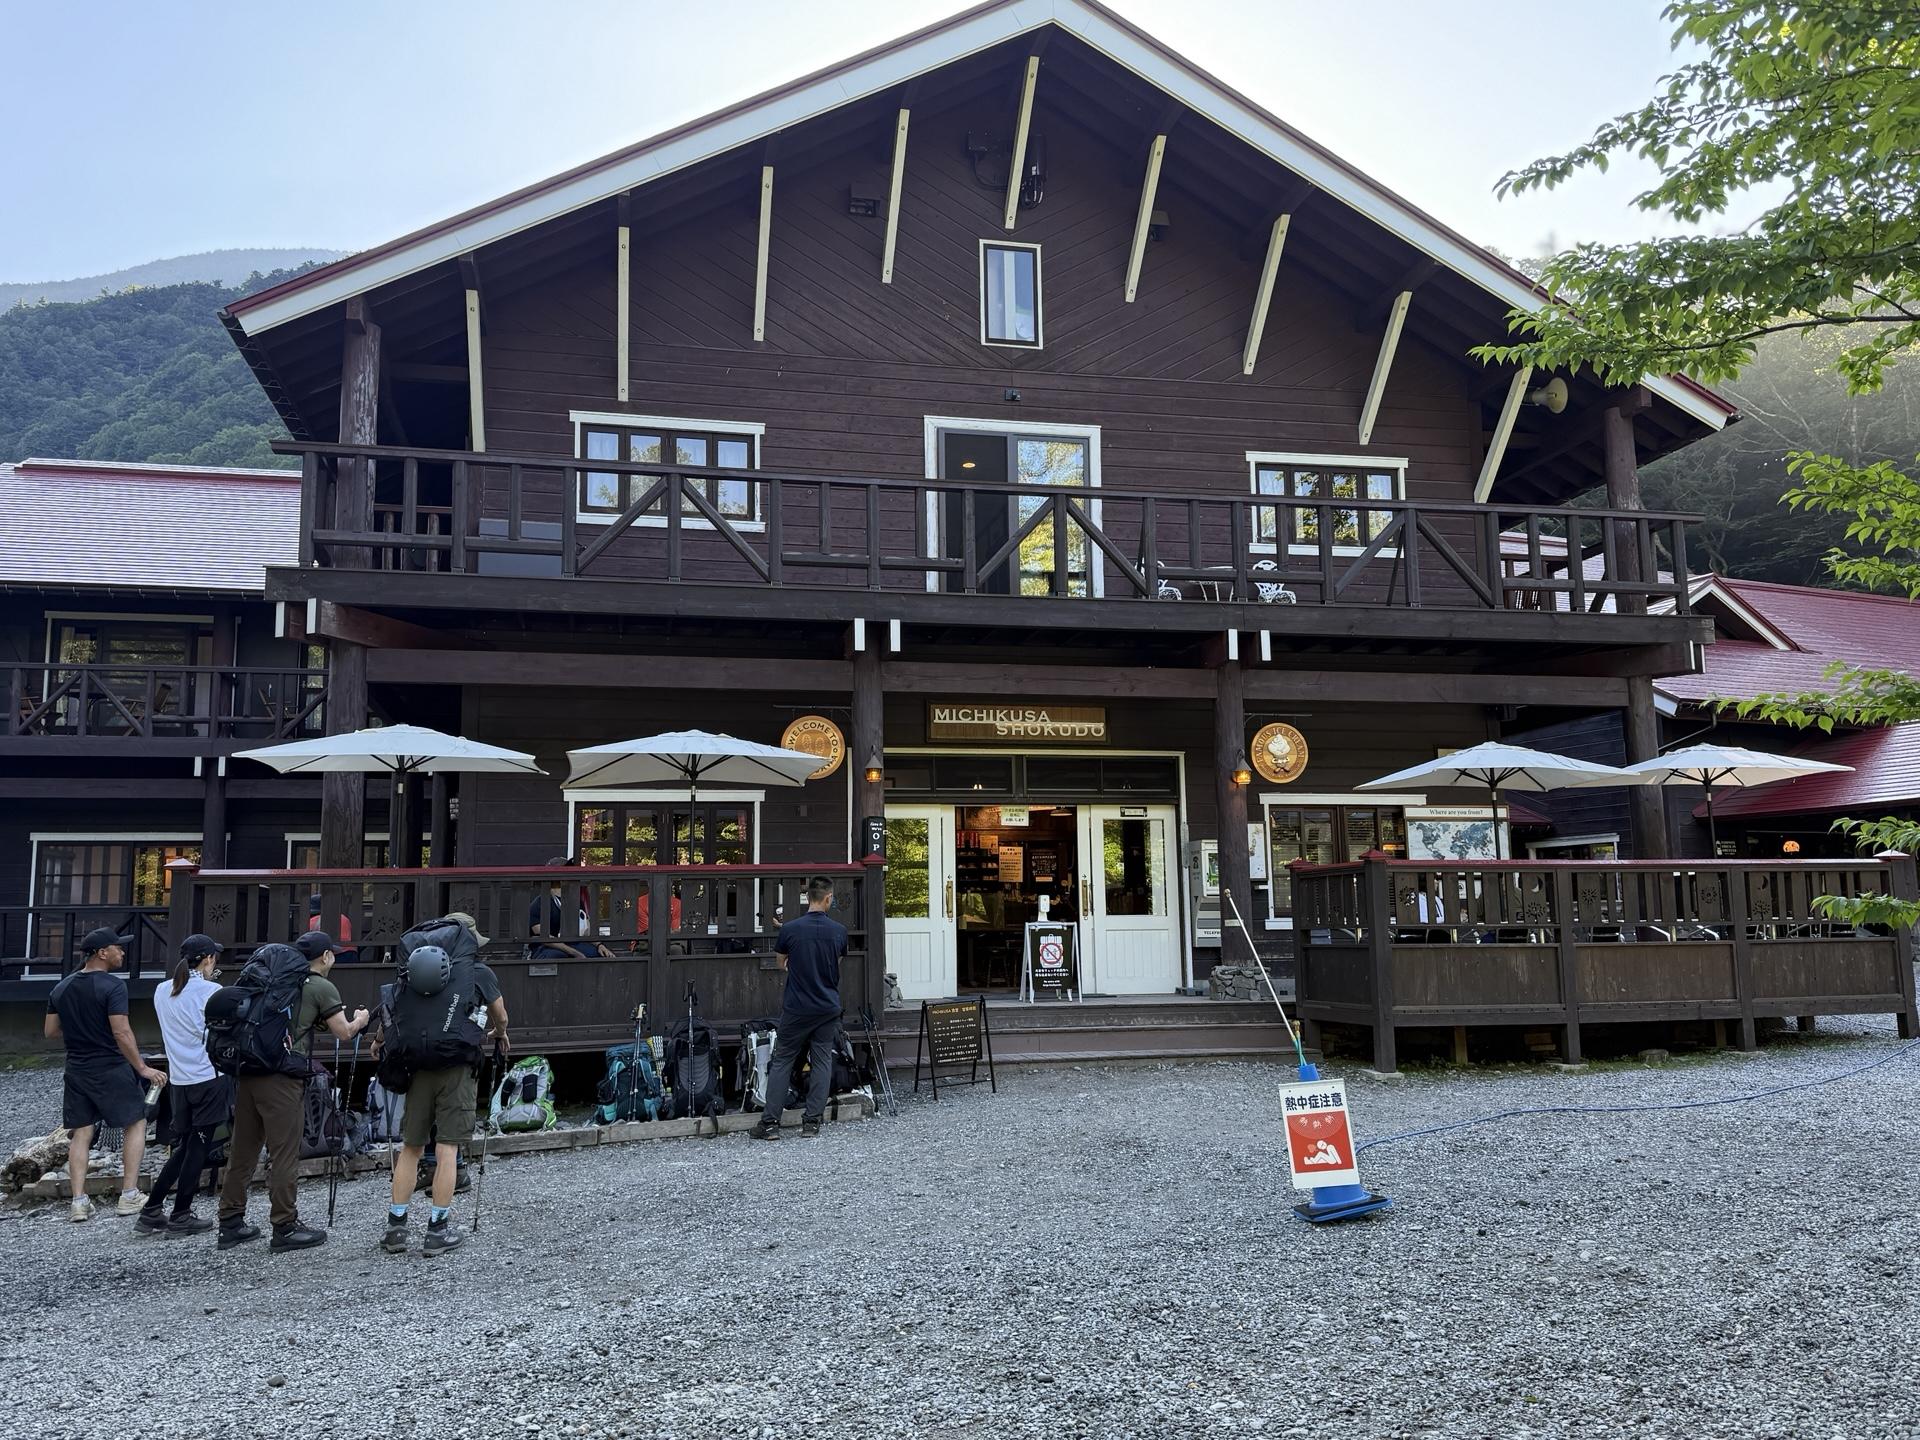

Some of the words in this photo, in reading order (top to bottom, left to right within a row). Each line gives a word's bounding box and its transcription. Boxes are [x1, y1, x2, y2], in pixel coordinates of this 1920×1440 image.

[934, 708, 1050, 722] MICHIKUSA
[787, 721, 831, 746] WELCOME
[829, 732, 838, 747] TO
[996, 723, 1105, 737] SHOKUDO
[1255, 730, 1272, 763] FAMOUS
[1272, 727, 1286, 735] ICE
[1288, 730, 1305, 758] CREAM
[1285, 1092, 1343, 1111] 熱中症注意
